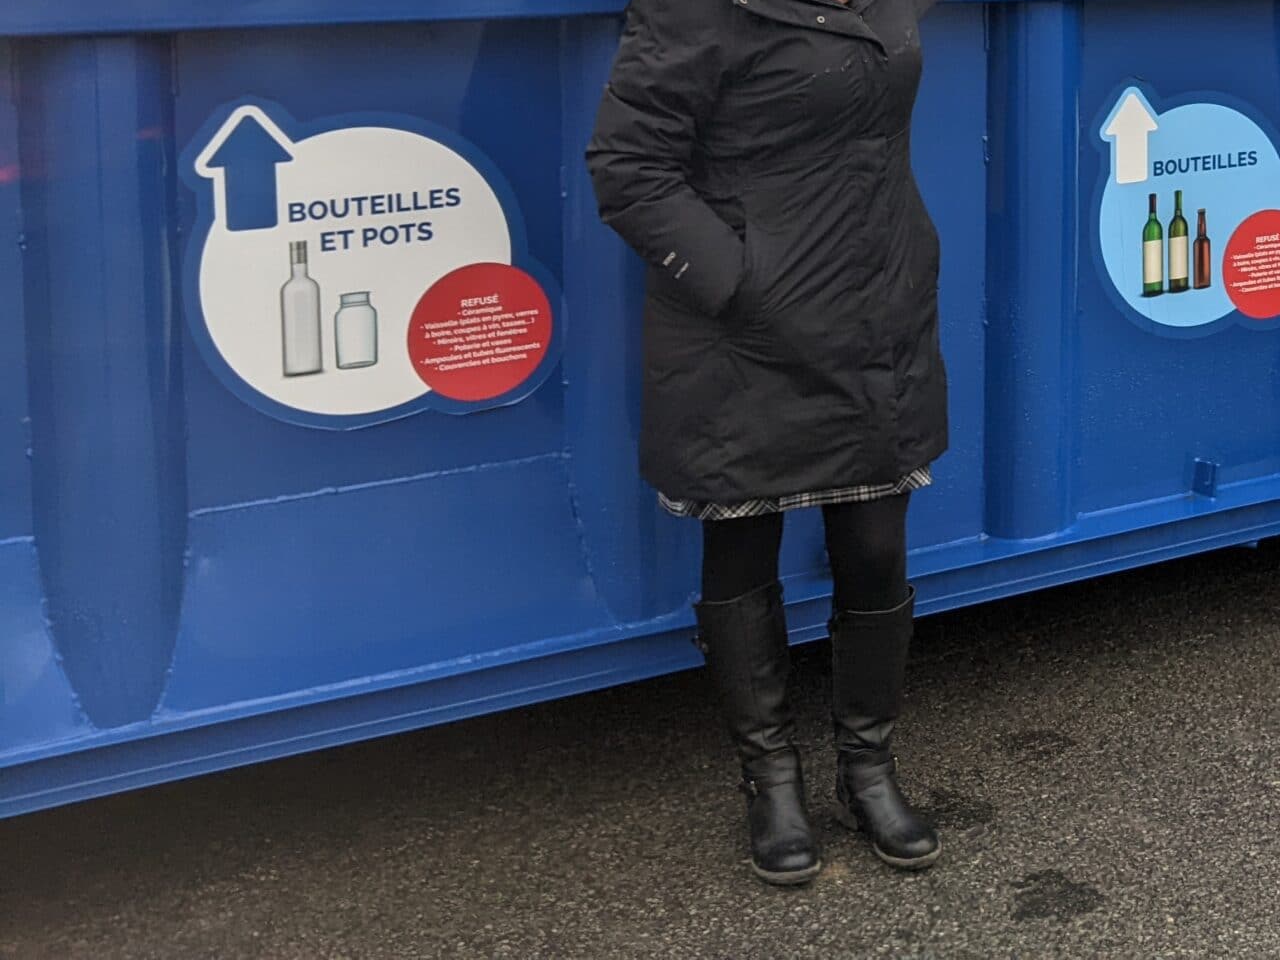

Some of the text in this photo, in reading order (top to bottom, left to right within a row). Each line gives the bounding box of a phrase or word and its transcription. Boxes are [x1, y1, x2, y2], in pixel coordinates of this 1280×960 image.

[1153, 150, 1258, 177] BOUTEILLES
[288, 187, 461, 223] BOUTEILLES
[320, 222, 433, 252] ET POTS
[461, 294, 499, 307] REFUSÉ
